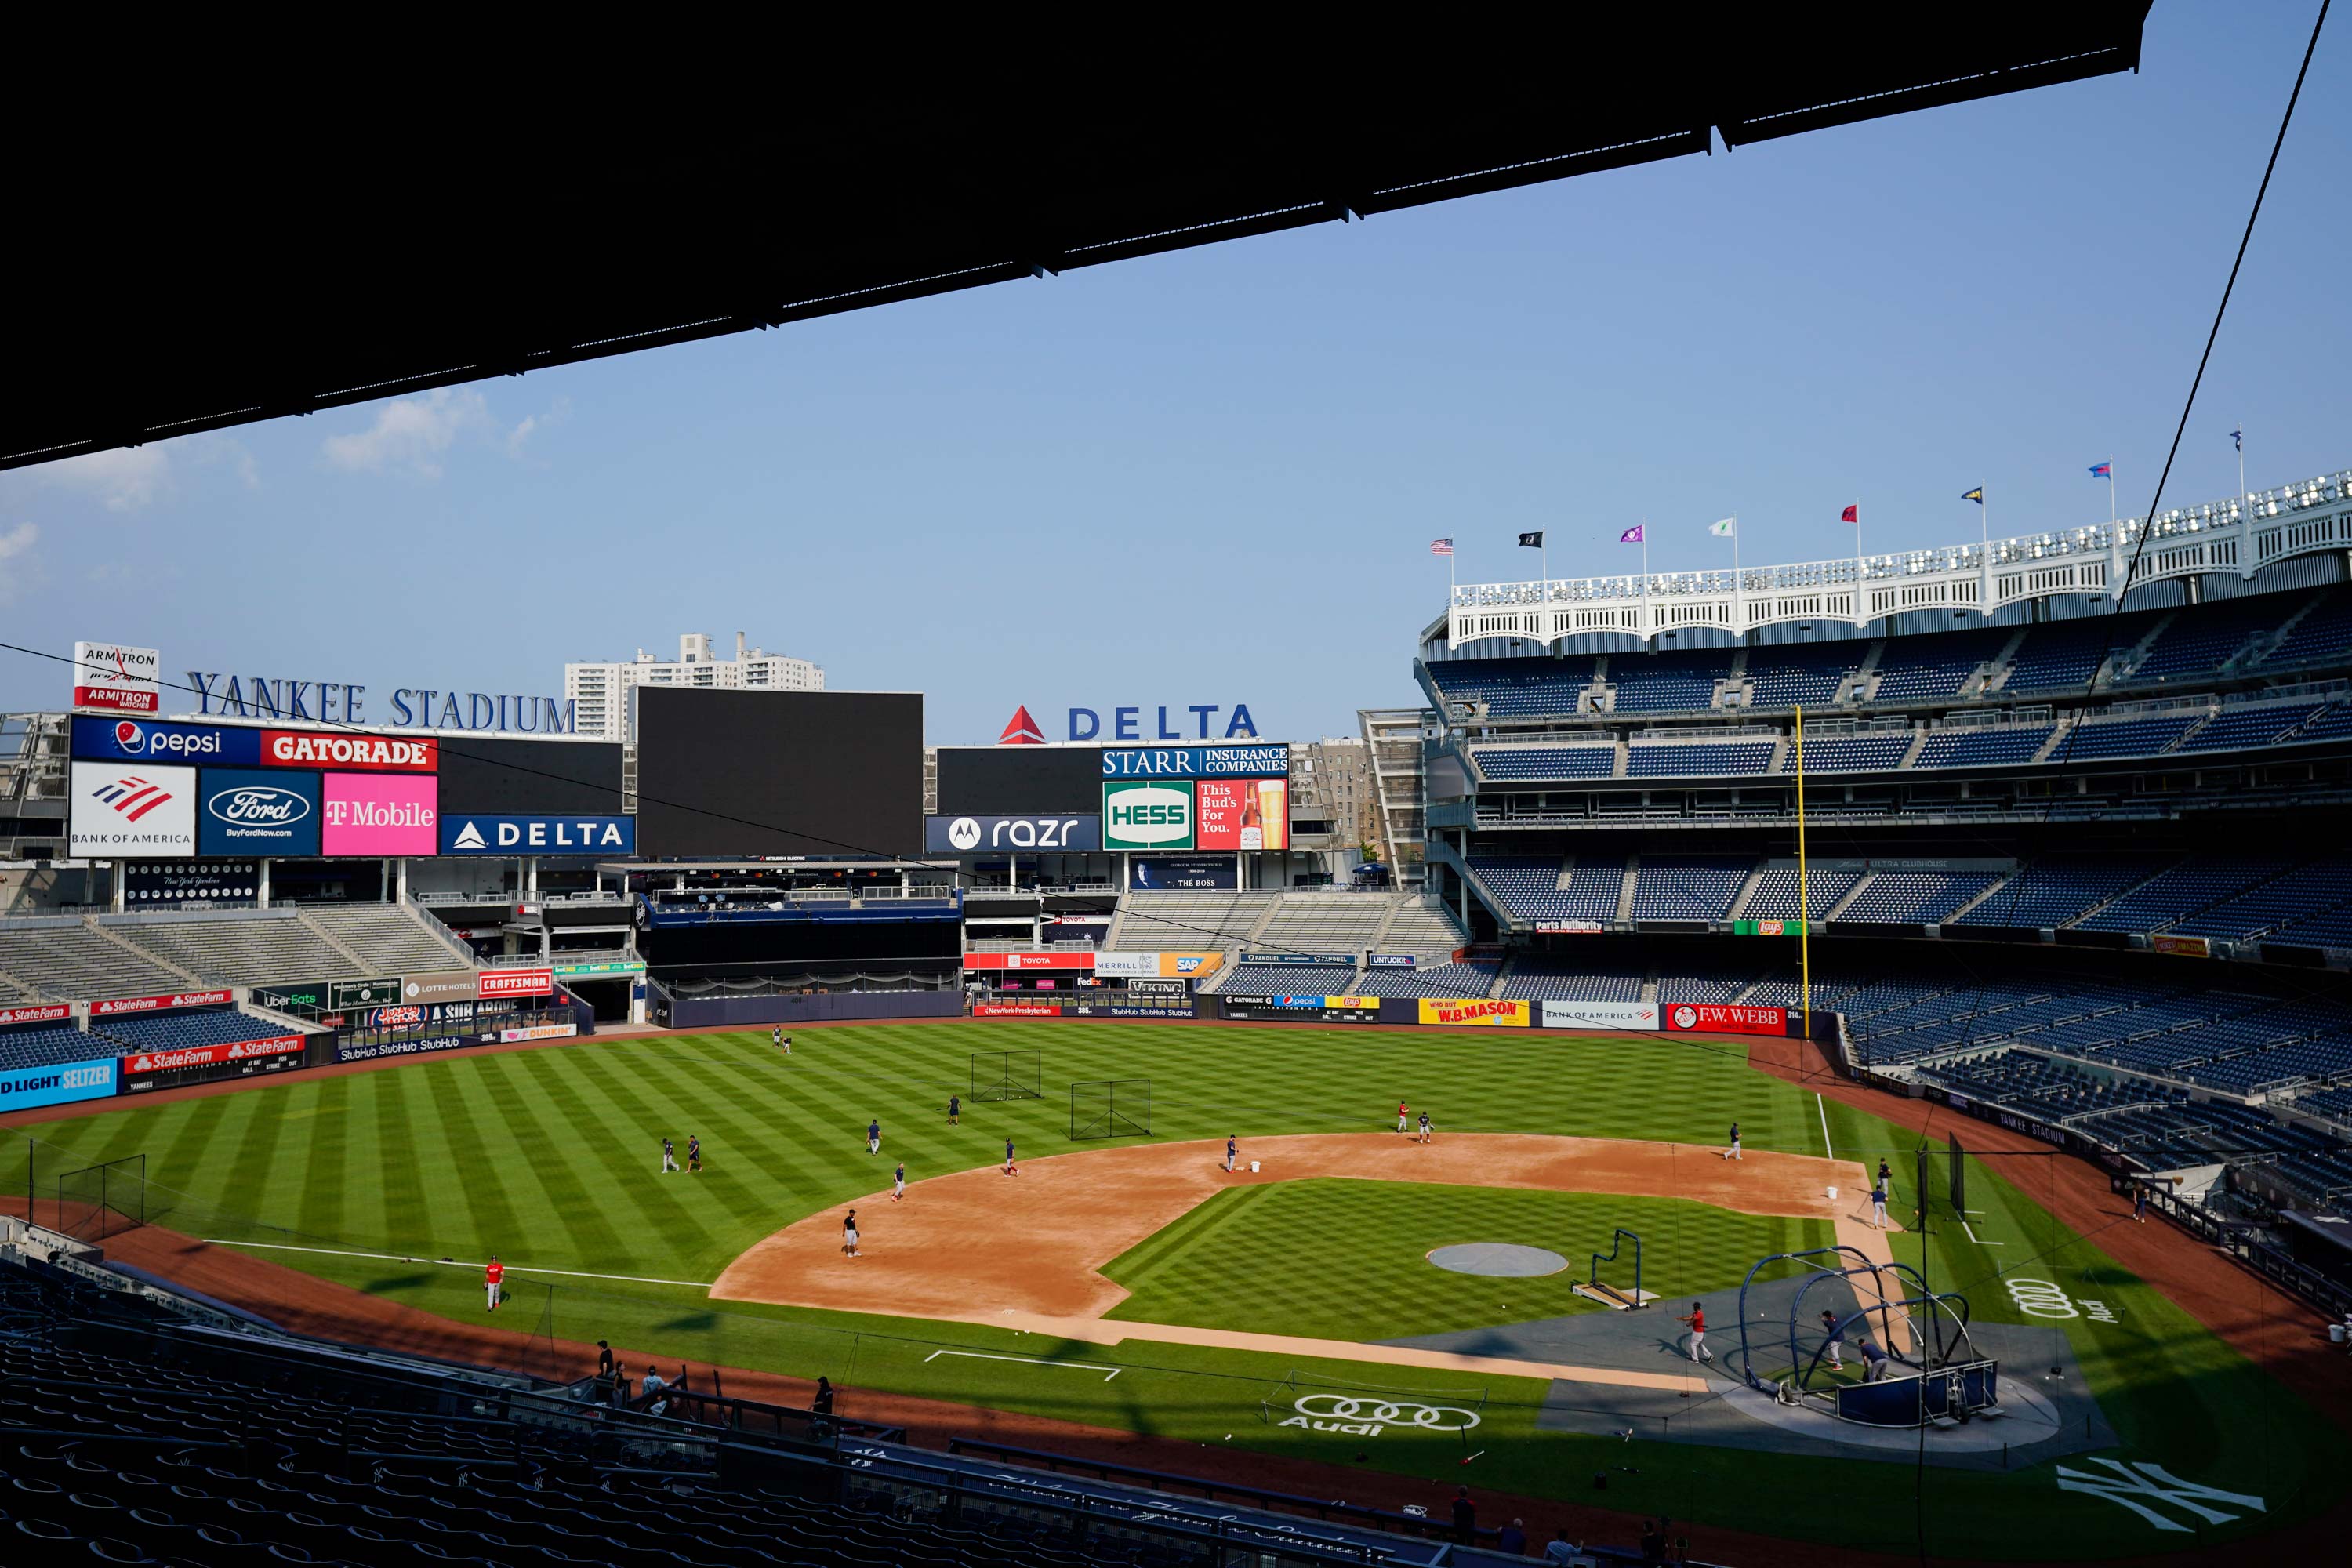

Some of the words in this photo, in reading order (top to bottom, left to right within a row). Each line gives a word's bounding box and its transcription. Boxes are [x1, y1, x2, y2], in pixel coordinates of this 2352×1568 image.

[85, 649, 155, 665] ARMITRON
[88, 689, 151, 703] ARMITRON
[186, 670, 366, 724] YANKEE
[390, 688, 578, 735] STADIUM
[118, 701, 150, 710] WATCHES
[1069, 703, 1259, 741] DELTA
[150, 730, 221, 757] pepsi
[273, 736, 428, 765] GATORADE
[1205, 747, 1288, 761] INSURANCE
[1102, 750, 1196, 775] STARR
[1205, 759, 1288, 773] COMPANIES
[1201, 783, 1231, 796] This
[226, 790, 293, 820] Ford
[1202, 796, 1237, 808] Bud's
[351, 800, 434, 827] Mobile
[1112, 804, 1185, 826] HESS
[1202, 808, 1225, 820] For
[226, 829, 292, 837] BuyFordNow.com
[498, 822, 623, 846] DELTA
[992, 819, 1079, 847] razr
[1201, 821, 1230, 833] You.
[71, 833, 108, 844] BANK
[112, 833, 129, 844] OF
[132, 834, 191, 844] AMERICA
[179, 877, 194, 887] York
[194, 877, 220, 887] Yankees
[1536, 920, 1560, 930] Parts
[1560, 920, 1602, 931] Authority
[1177, 960, 1199, 971] SAP
[421, 984, 448, 993] LOTTE
[448, 982, 476, 991] HOTELS
[483, 977, 548, 990] CRAFTSMAN
[1077, 977, 1102, 986] FedEx
[1131, 981, 1181, 996] VIKING
[265, 996, 291, 1007] Uber
[291, 994, 316, 1005] Eats
[1139, 1008, 1166, 1017] StubHub
[1588, 1011, 1633, 1020] AMERICA
[1699, 1007, 1727, 1022] F.W.
[1730, 1008, 1779, 1025] WEBB
[529, 1026, 571, 1039] DUNKIN'
[379, 1040, 417, 1055] StubHub
[419, 1037, 459, 1051] StubHub
[340, 1047, 376, 1061] StubHub
[266, 1062, 281, 1071] STRIKE
[14, 1075, 61, 1092] LIGHT
[62, 1065, 111, 1091] SELTZER
[130, 1080, 154, 1091] YANKEES
[2000, 1113, 2027, 1132] YANKEE
[2031, 1123, 2066, 1145] STADIUM
[2076, 1298, 2118, 1323] Audi
[1277, 1415, 1385, 1437] Audi
